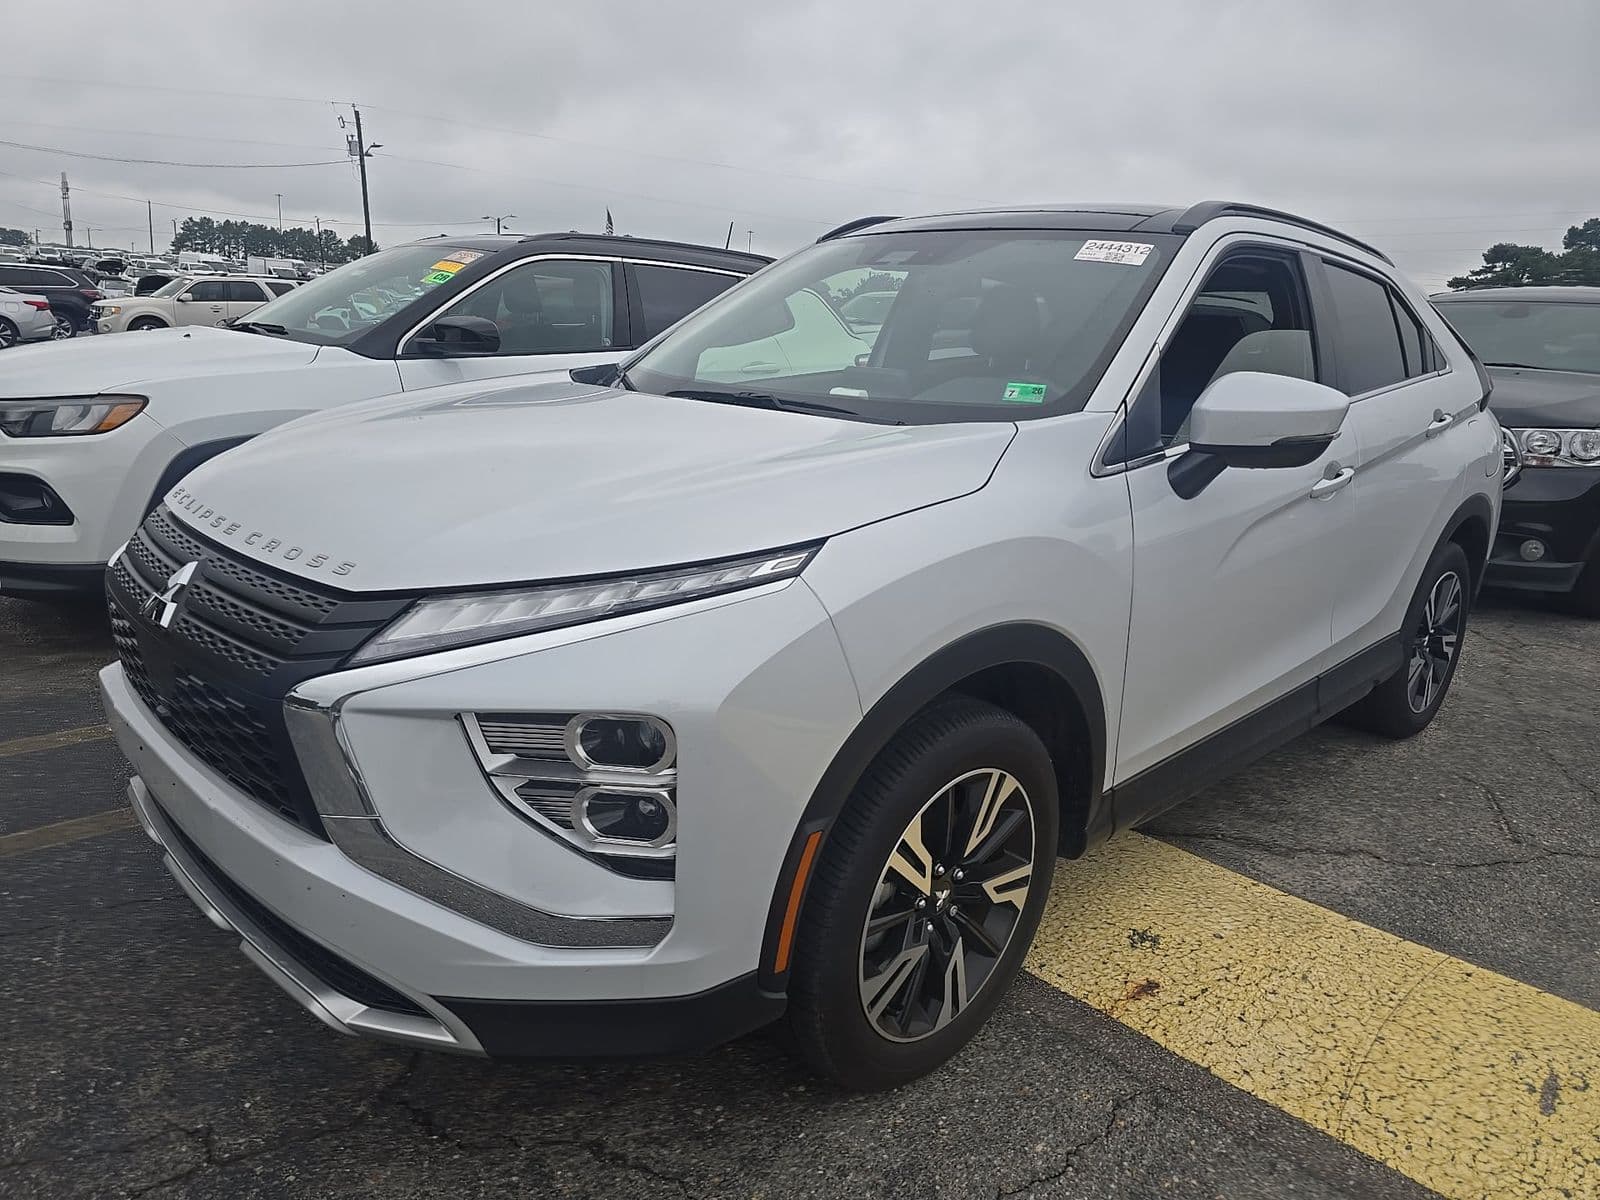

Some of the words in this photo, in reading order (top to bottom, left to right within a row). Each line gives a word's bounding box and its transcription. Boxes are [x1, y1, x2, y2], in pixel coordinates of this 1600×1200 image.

[1085, 242, 1152, 255] 2444312
[172, 488, 242, 536] ECLIPSE
[244, 531, 357, 576] CROSS
